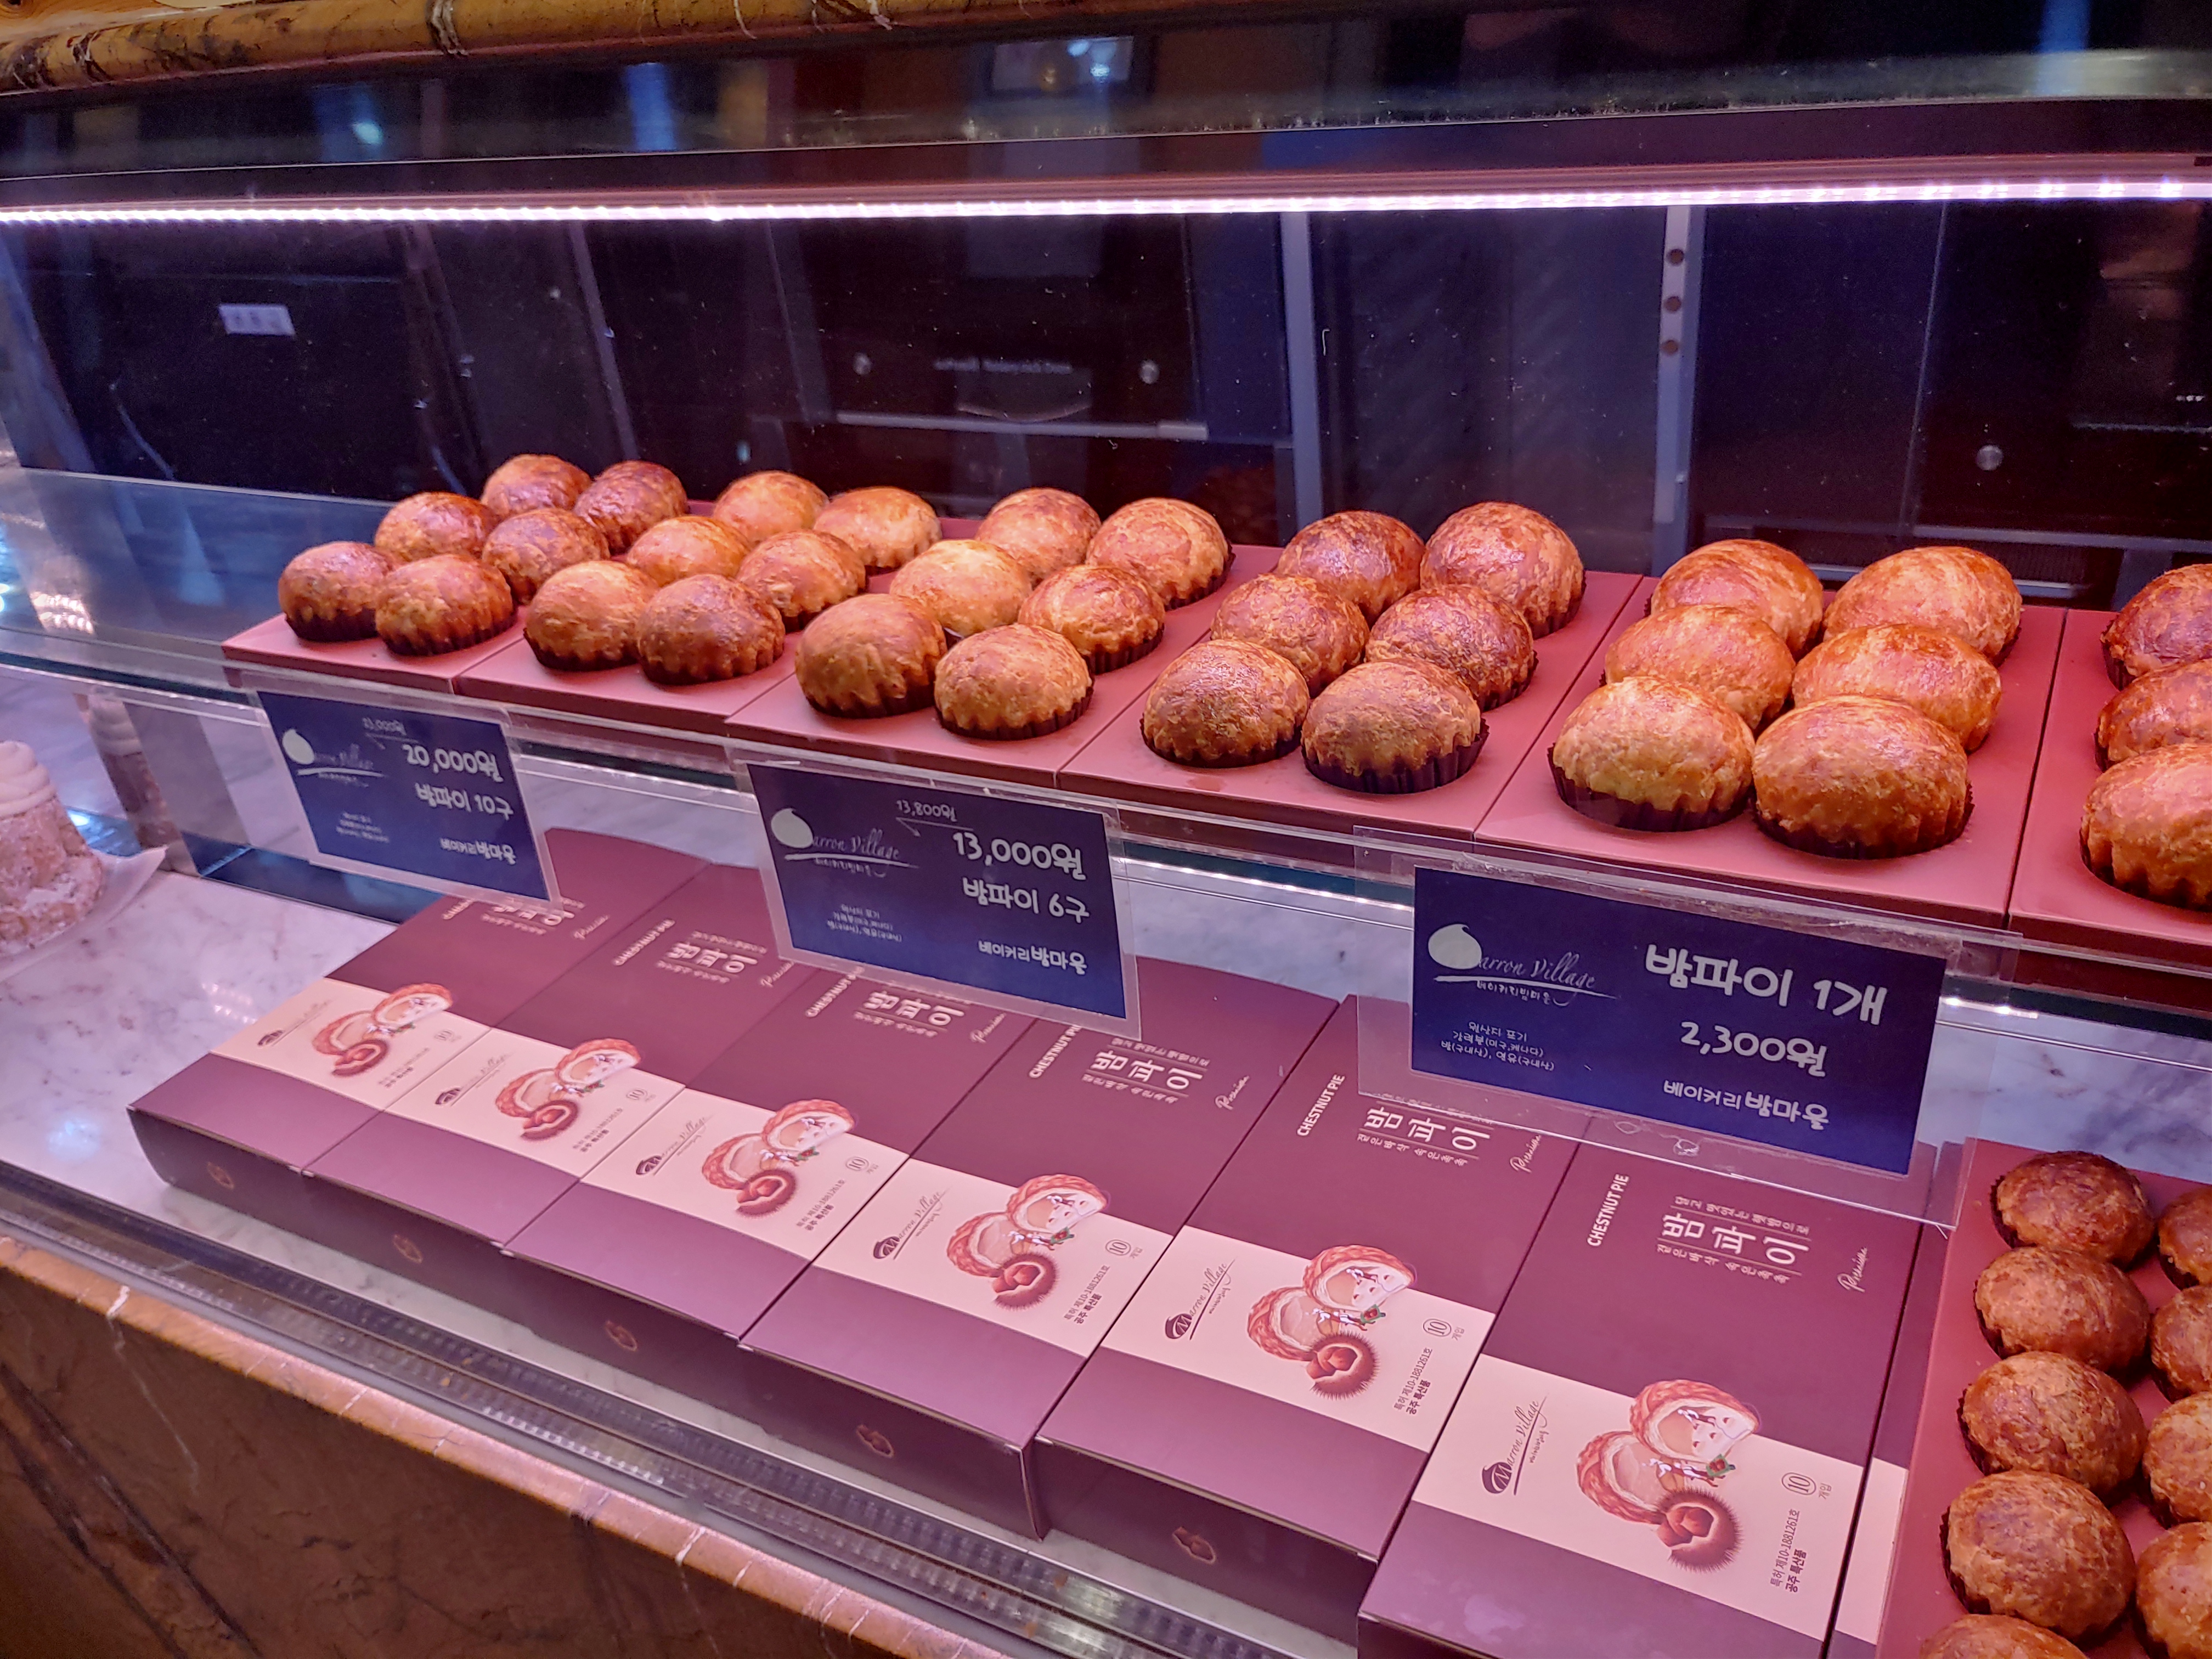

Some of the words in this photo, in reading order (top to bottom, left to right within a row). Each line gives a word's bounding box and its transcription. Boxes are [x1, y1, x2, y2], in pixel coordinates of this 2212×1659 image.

[402, 743, 503, 782] 20,000원
[415, 782, 471, 812] 밤파이
[474, 794, 514, 820] 10구
[897, 800, 957, 822] 13,800원
[953, 832, 1086, 880] 13,000원
[962, 877, 1039, 914] 밤파이
[1048, 893, 1090, 923] 6구
[667, 942, 758, 973] 밤파이
[978, 940, 1087, 975] 베이커리밤마을
[1531, 951, 1595, 990] Village
[1645, 944, 1793, 1007] 밤파이
[1814, 979, 1887, 1025] 1개
[863, 991, 965, 1026] 밤파이
[1469, 1022, 1501, 1036] 원산지
[1506, 1029, 1527, 1042] 표기
[1681, 1022, 1827, 1077] 2,300원
[1029, 1033, 1071, 1079] CHESTNUT
[1091, 1049, 1203, 1090] 밤파이
[1297, 1087, 1331, 1137] CHESTNUT
[1327, 1074, 1345, 1092] PIE
[1663, 1080, 1829, 1130] 베이커리밤마을
[1364, 1106, 1491, 1150] 밤파이
[849, 1159, 866, 1169] 10
[1587, 1189, 1622, 1247] CHESTNUT
[1614, 1173, 1629, 1193] PIE
[1109, 1242, 1128, 1254] 10
[1662, 1213, 1809, 1265] 밤파이
[1203, 1263, 1231, 1293] Village
[1427, 1322, 1447, 1335] 10
[1452, 1327, 1465, 1341] 개입
[1413, 1379, 1431, 1400] 특산품
[1406, 1400, 1421, 1415] 공주
[1515, 1401, 1547, 1437] Village
[1788, 1476, 1810, 1493] 10
[1819, 1482, 1832, 1500] 개입
[1776, 1508, 1800, 1570] 제10-1881261호
[1770, 1569, 1786, 1587] 특허
[1790, 1548, 1807, 1575] 특산품
[1785, 1575, 1801, 1593] 공주
